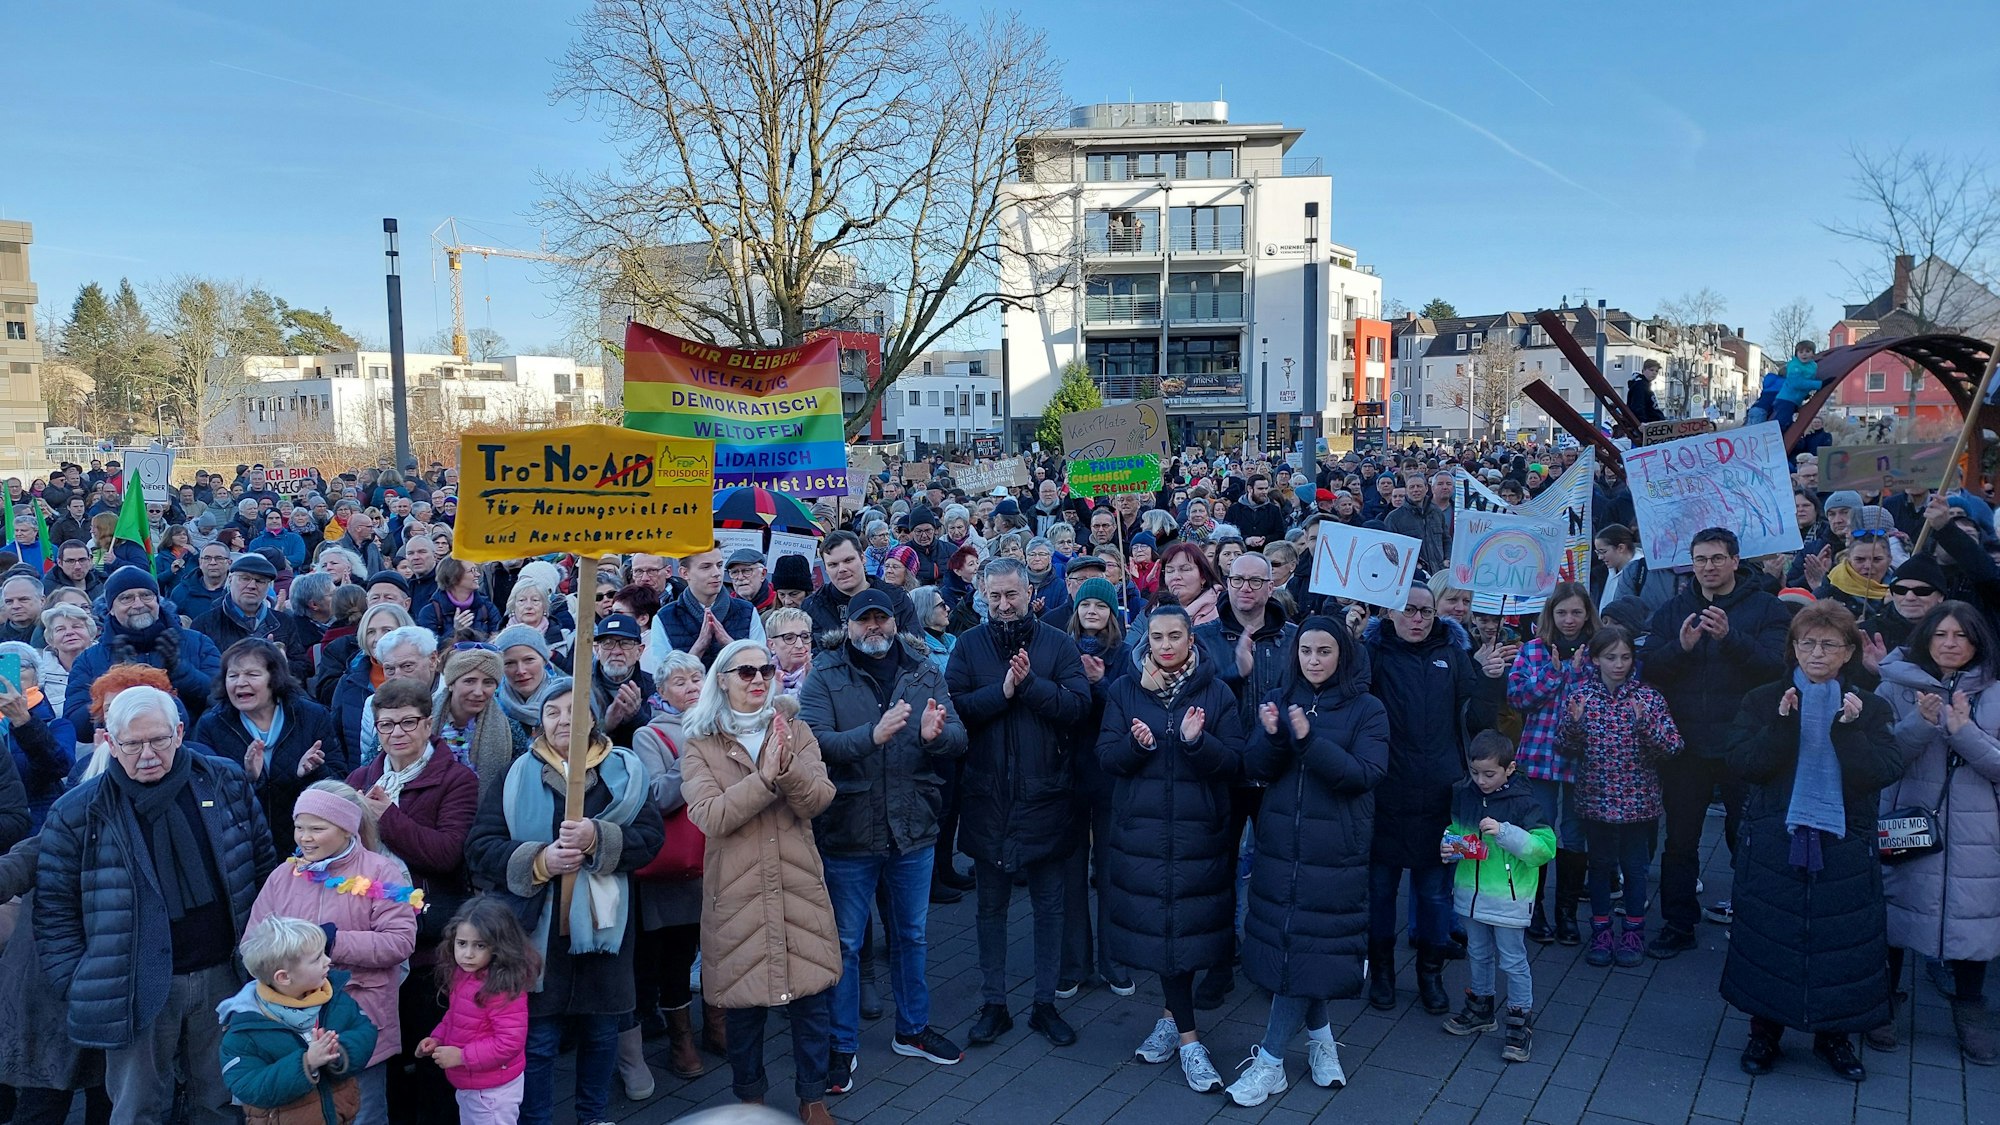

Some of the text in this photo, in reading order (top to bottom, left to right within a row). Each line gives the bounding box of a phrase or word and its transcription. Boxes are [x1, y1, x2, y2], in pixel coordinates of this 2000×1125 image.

[681, 342, 802, 370] WIR BLEIBEN:
[689, 367, 789, 393] VIELFÄLTIG
[672, 391, 818, 416] DEMOKRATISCH
[693, 421, 804, 440] WELTOFFEN
[1068, 413, 1128, 440] Kein Platz
[1646, 420, 1709, 437] GEGEN STOP
[714, 450, 813, 468] LIDARISCH
[1626, 432, 1780, 480] TROISDORF
[265, 468, 308, 480] ICH BIN
[658, 469, 710, 478] TROISDORF
[1089, 458, 1145, 473] FRIEDEN
[772, 477, 801, 492] Ist
[805, 474, 847, 491] Jetz
[1722, 465, 1781, 489] BUNT
[265, 480, 303, 494] DAGEG
[1092, 480, 1149, 494] FREIHEIT
[1469, 519, 1494, 534] WIR
[485, 530, 674, 544] und Menschenrechte
[1474, 562, 1538, 591] BUNT
[1888, 818, 1908, 830] LOVE
[1909, 818, 1928, 829] MOS
[1880, 836, 1921, 848] MOSCHINO
